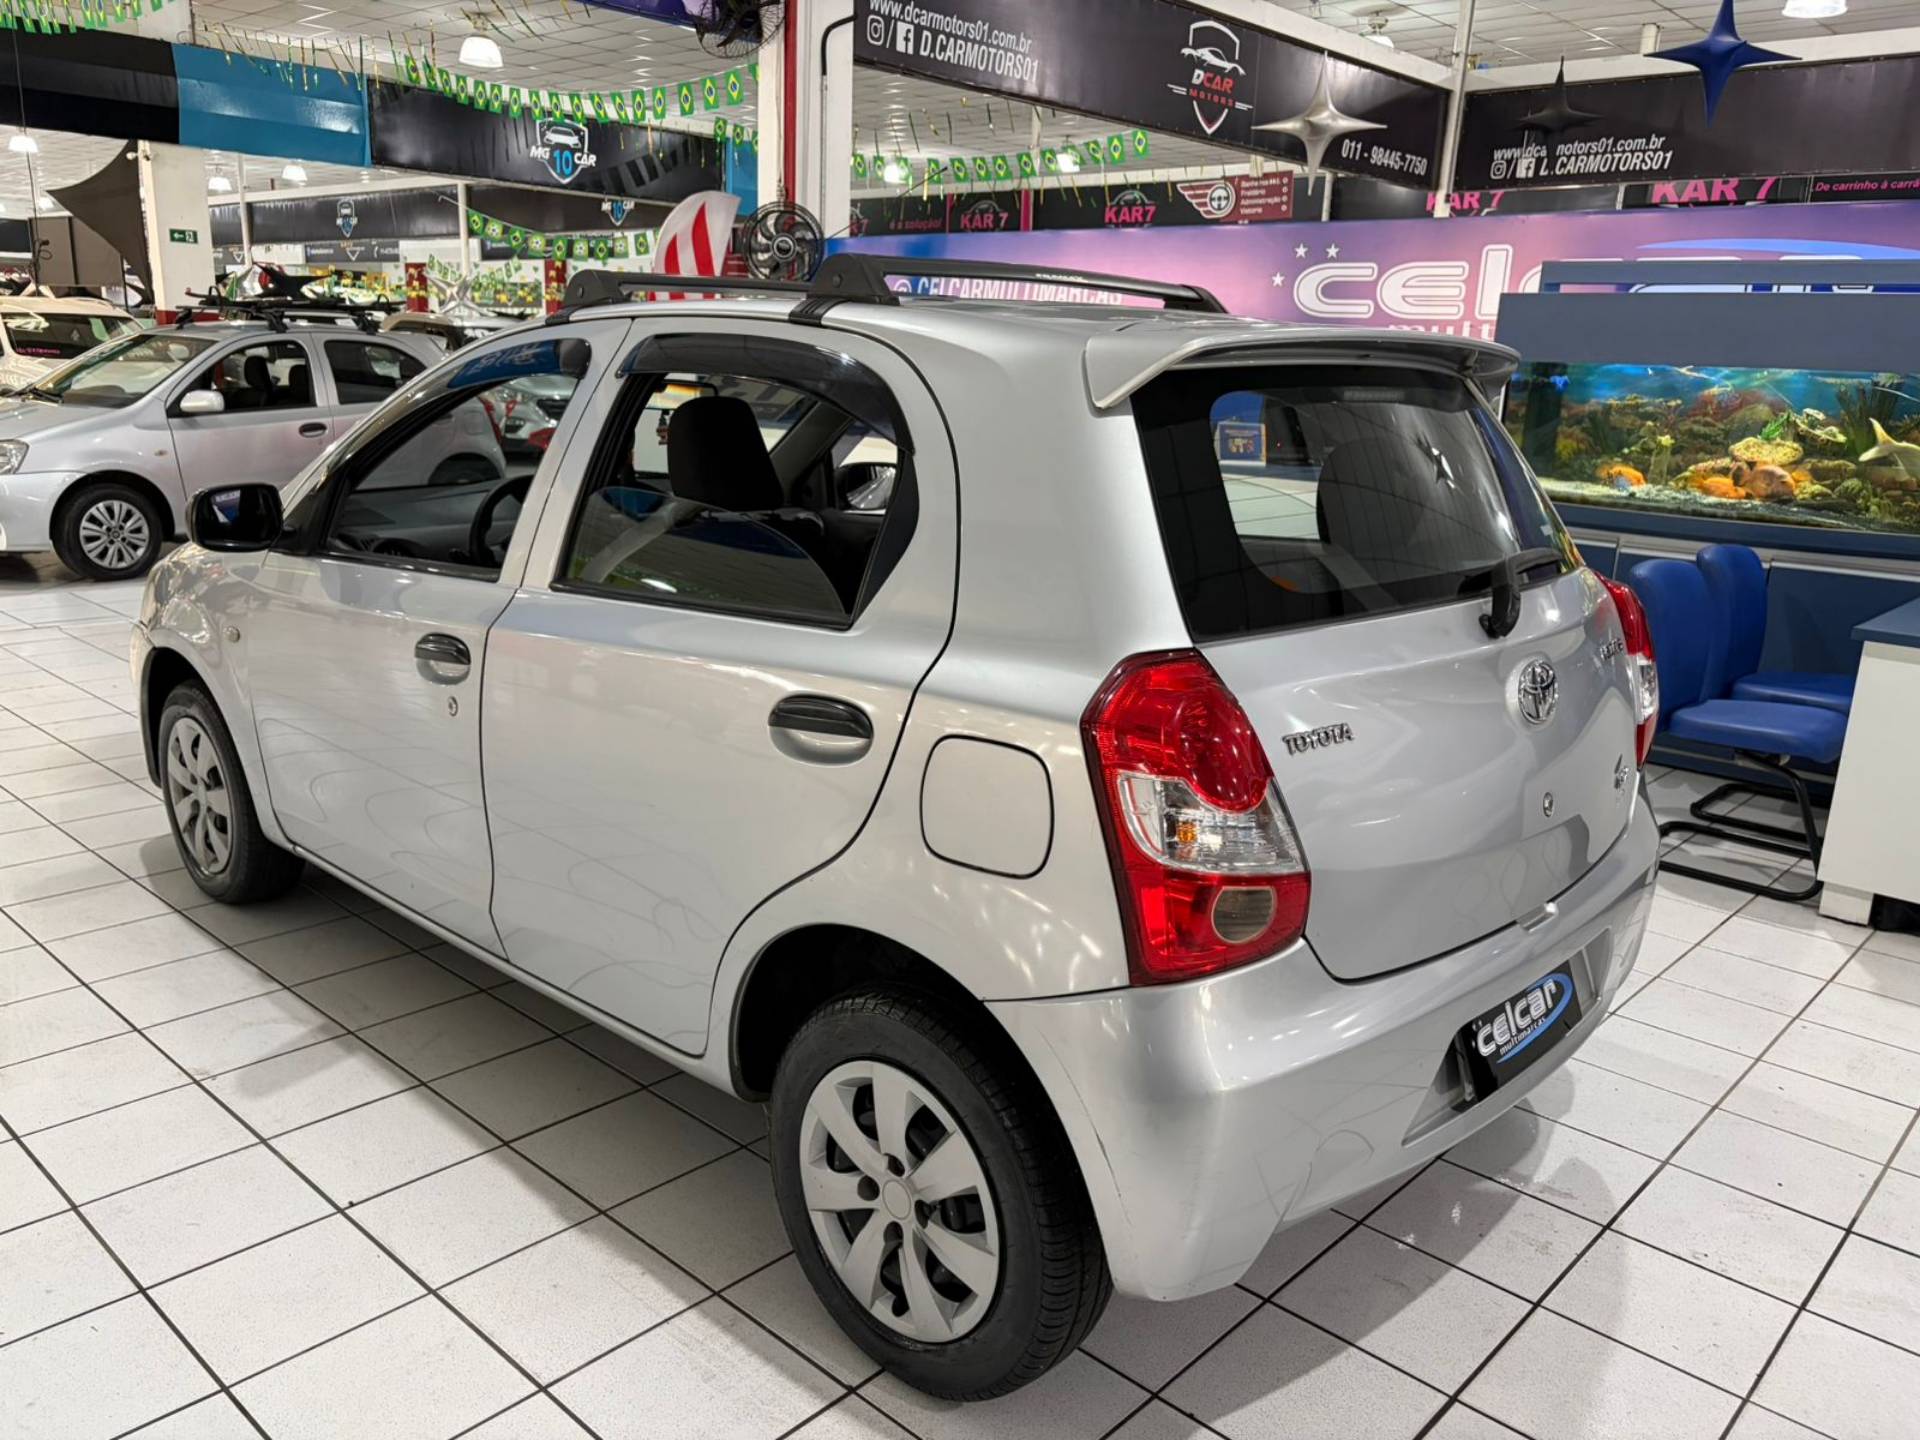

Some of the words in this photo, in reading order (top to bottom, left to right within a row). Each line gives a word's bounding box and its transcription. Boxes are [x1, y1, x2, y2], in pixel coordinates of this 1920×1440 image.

[920, 30, 1039, 83] D.CARMOTORS01
[1192, 69, 1234, 93] DCAR
[1189, 88, 1234, 107] MOTORS
[530, 146, 550, 159] MG
[553, 150, 573, 176] 10
[574, 153, 597, 167] CAR
[1341, 139, 1362, 160] 011
[1370, 146, 1428, 176] 98445-7750
[1652, 177, 1739, 203] KAR
[1756, 176, 1779, 201] 7
[1815, 182, 1829, 192] De
[1832, 180, 1878, 191] carrinho
[960, 213, 994, 229] KAR
[1282, 723, 1355, 756] TOYOTA
[1477, 978, 1557, 1057] celcar
[1500, 1017, 1547, 1056] multimarcas
